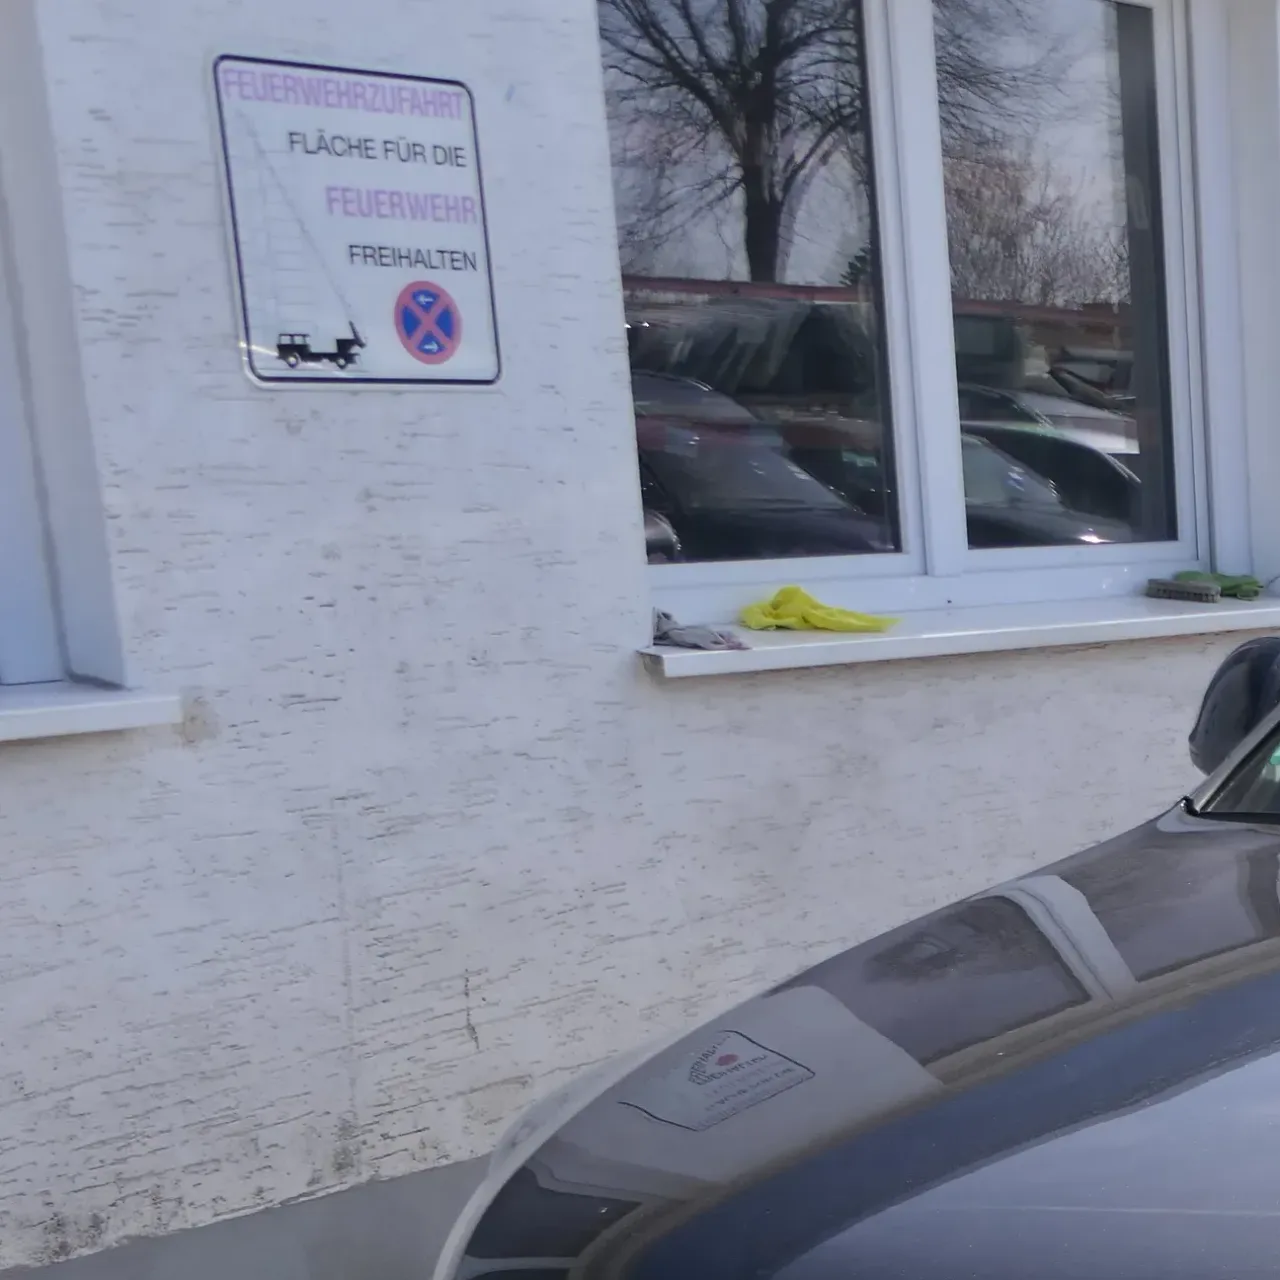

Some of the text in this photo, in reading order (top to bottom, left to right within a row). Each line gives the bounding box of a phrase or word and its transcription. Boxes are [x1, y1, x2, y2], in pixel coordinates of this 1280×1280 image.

[223, 68, 464, 120] FEUERWEHRZUFAHRT
[288, 129, 467, 168] FLÄCHE FÜR DIE
[325, 186, 478, 225] FEUERWEHR
[348, 245, 478, 272] FREIHALTEN
